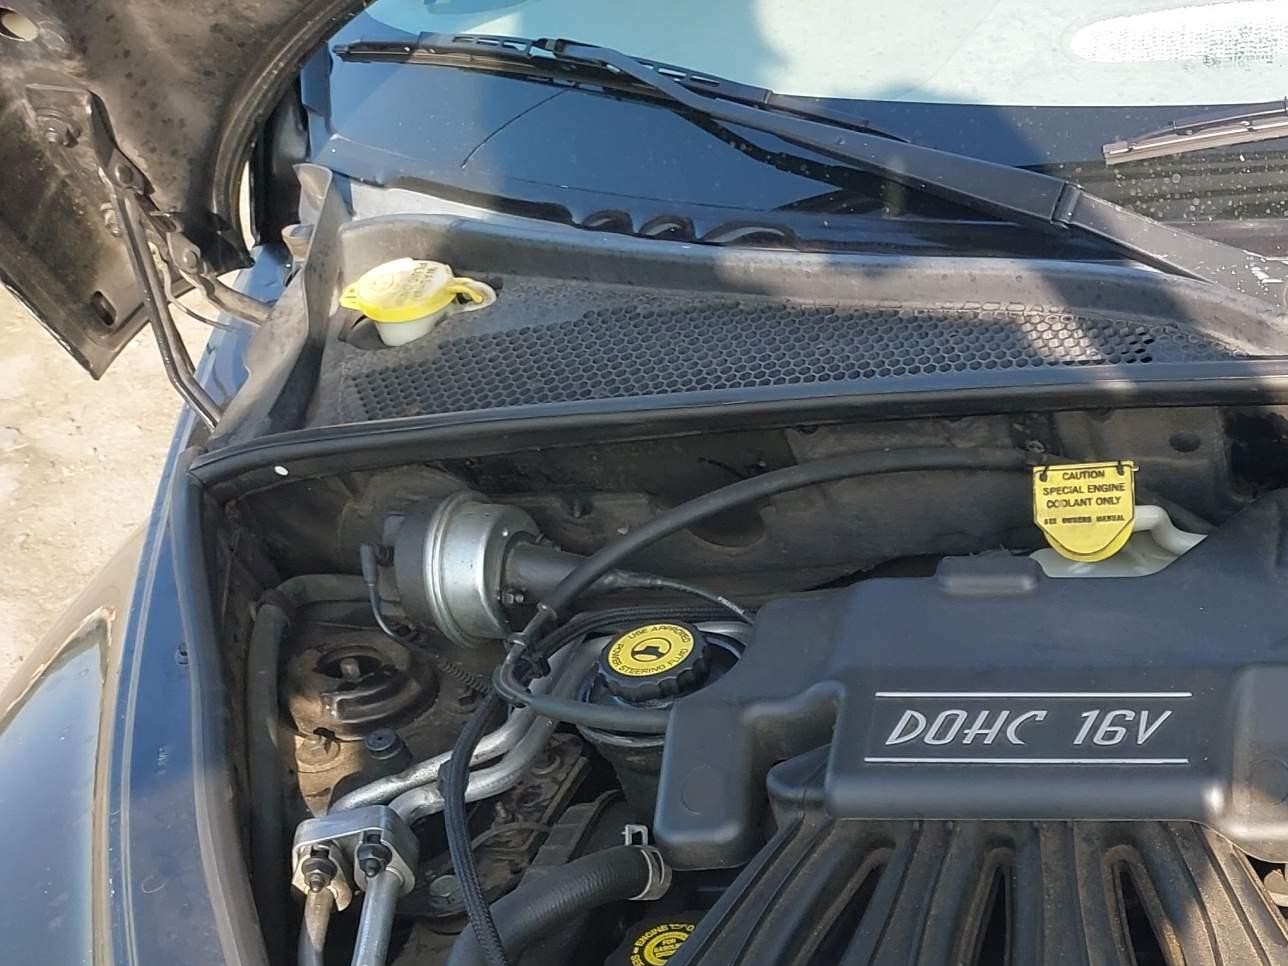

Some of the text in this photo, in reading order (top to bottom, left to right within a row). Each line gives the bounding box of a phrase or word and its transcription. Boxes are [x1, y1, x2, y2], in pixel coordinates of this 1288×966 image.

[1062, 470, 1105, 481] CAUTION
[1042, 483, 1126, 496] SPECIAL ENGINE
[1096, 496, 1122, 506] ONLY
[628, 625, 691, 643] USE APPROVED
[611, 643, 689, 675] POWER STEERING FLUID
[885, 708, 1172, 746] DOHC 16V
[633, 923, 669, 947] ENGINE
